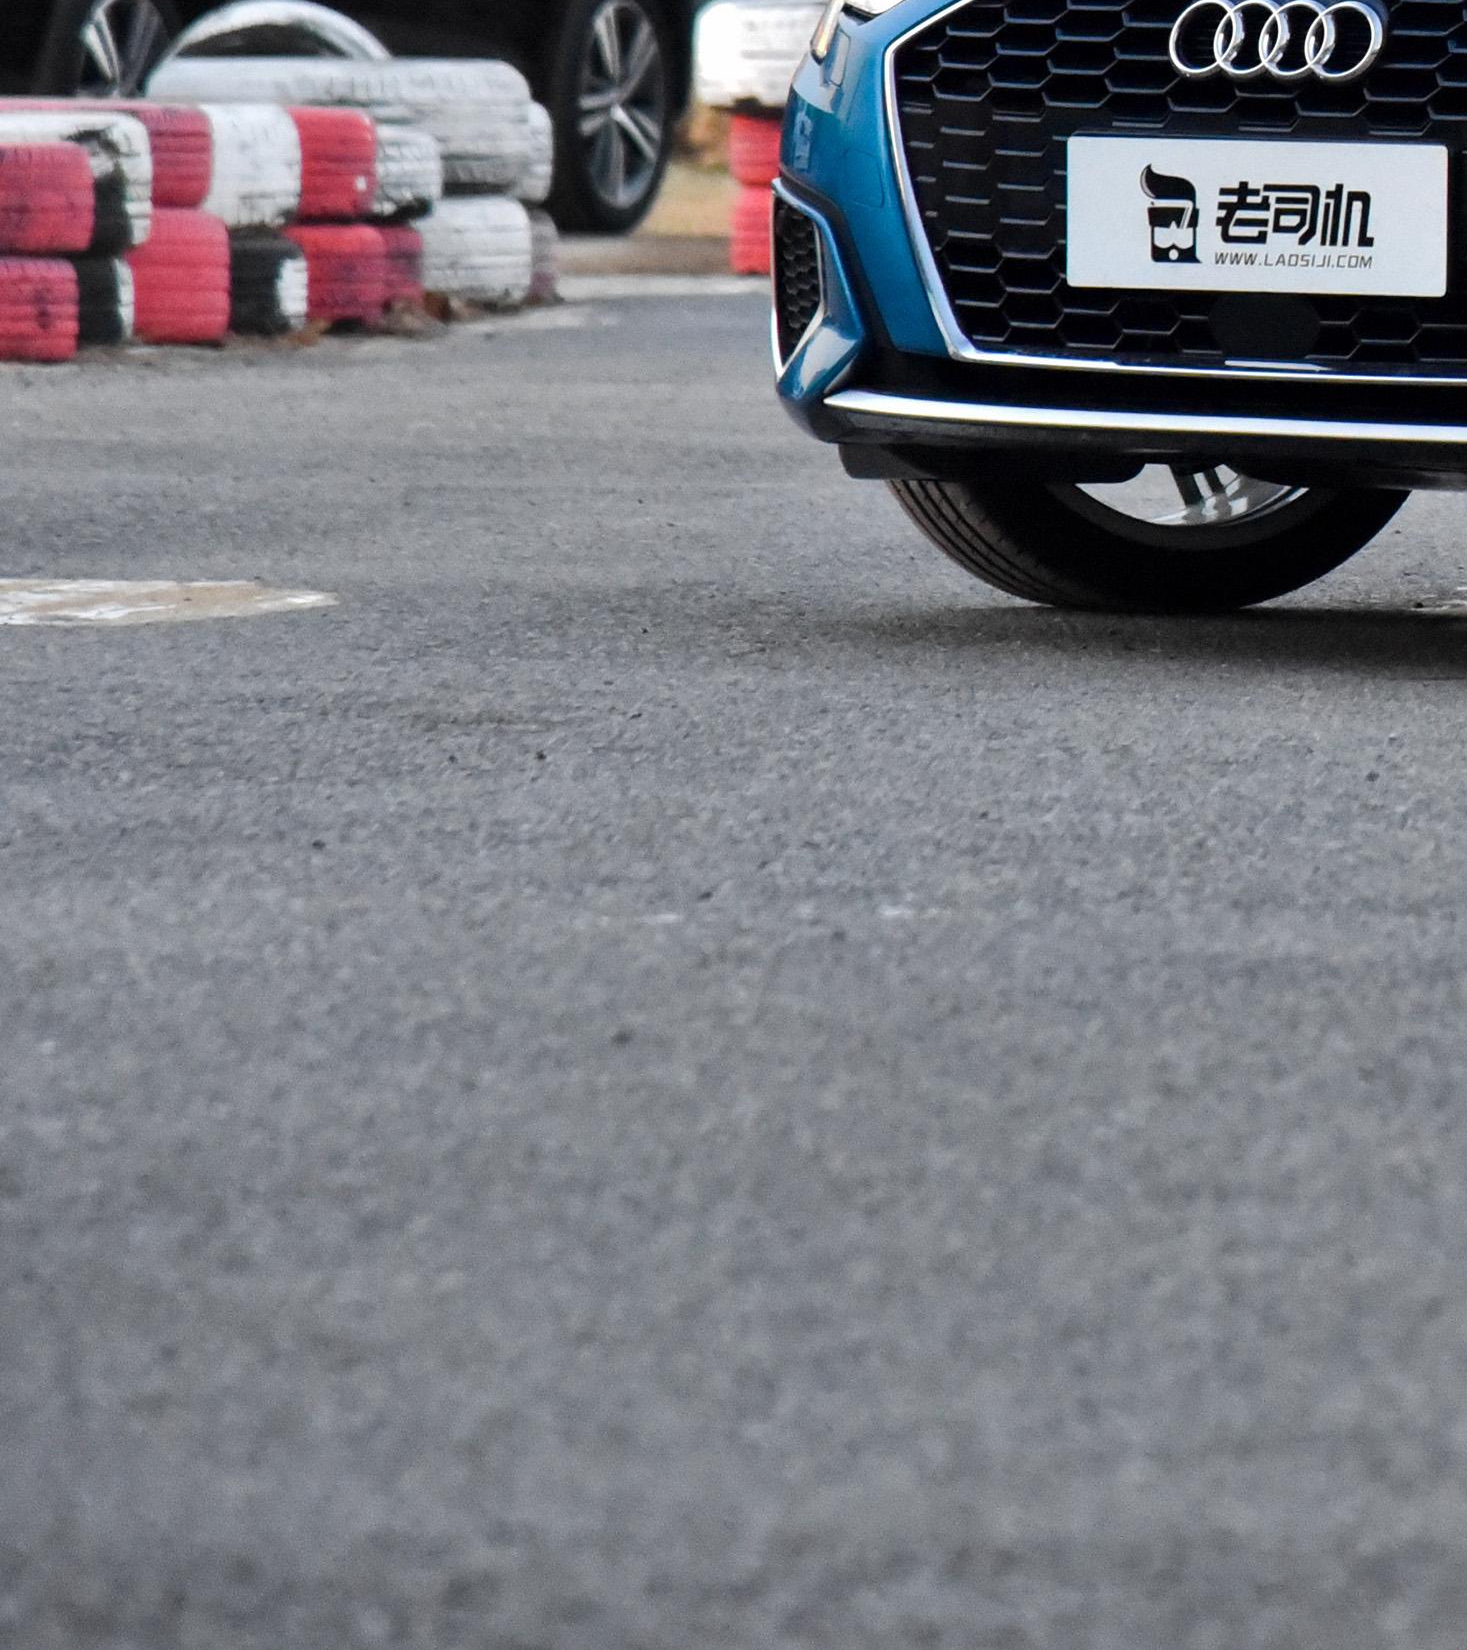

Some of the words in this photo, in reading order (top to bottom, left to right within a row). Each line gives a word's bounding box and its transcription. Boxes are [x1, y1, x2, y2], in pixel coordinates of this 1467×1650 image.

[1215, 181, 1374, 247] 老司机
[1214, 251, 1373, 269] WWW.LAOSIJI.COM
